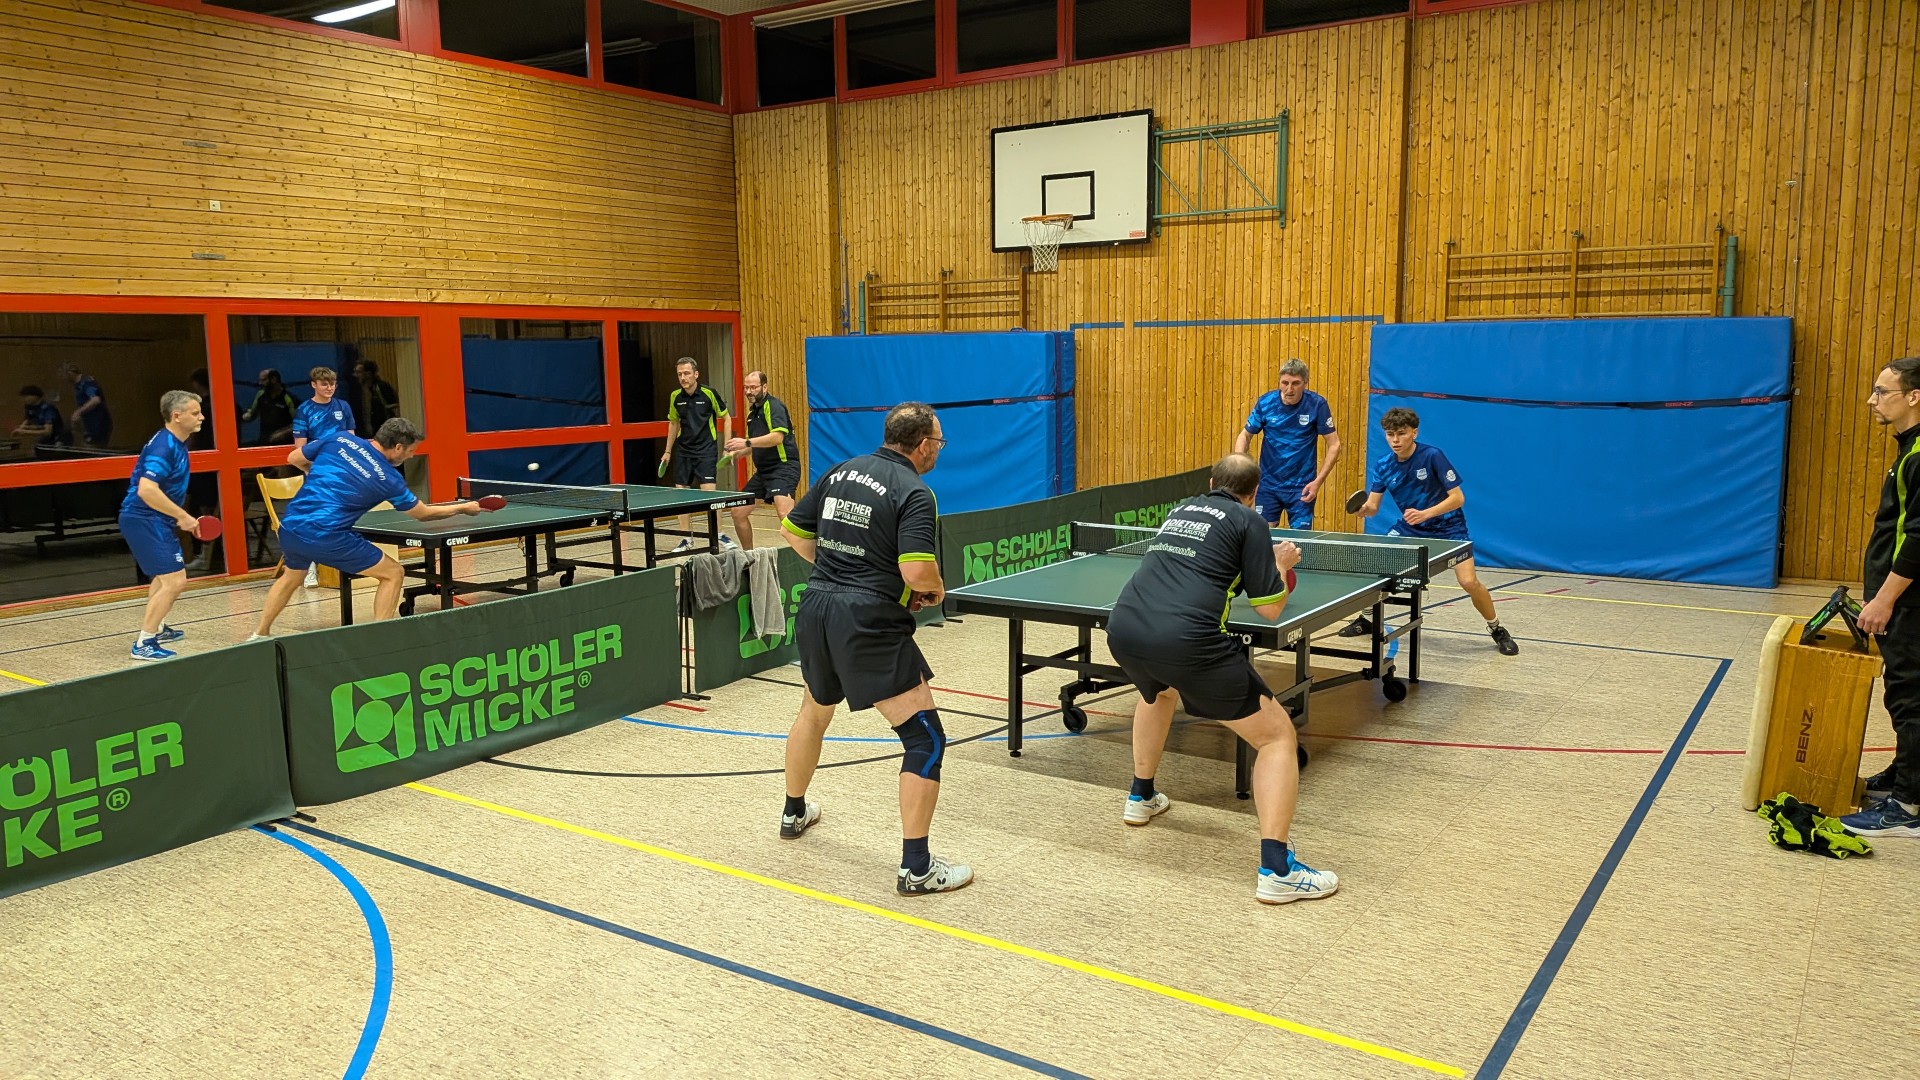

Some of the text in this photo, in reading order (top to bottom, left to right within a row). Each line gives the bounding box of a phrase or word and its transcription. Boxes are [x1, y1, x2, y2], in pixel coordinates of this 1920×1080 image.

[1740, 396, 1772, 405] BENZ
[337, 447, 372, 479] Tischtennis
[828, 469, 888, 497] TV Belsen
[836, 498, 873, 517] DIETHER
[1183, 504, 1227, 520] Belsen
[1168, 518, 1212, 533] DIETHER
[446, 535, 469, 546] GEWO
[816, 536, 866, 557] Tischtennis
[996, 523, 1071, 564] SCHÖLE
[1402, 577, 1421, 585] GEWO
[1286, 627, 1303, 644] GEWO
[419, 624, 622, 706] SCHÖLER
[1795, 709, 1814, 764] BENZ
